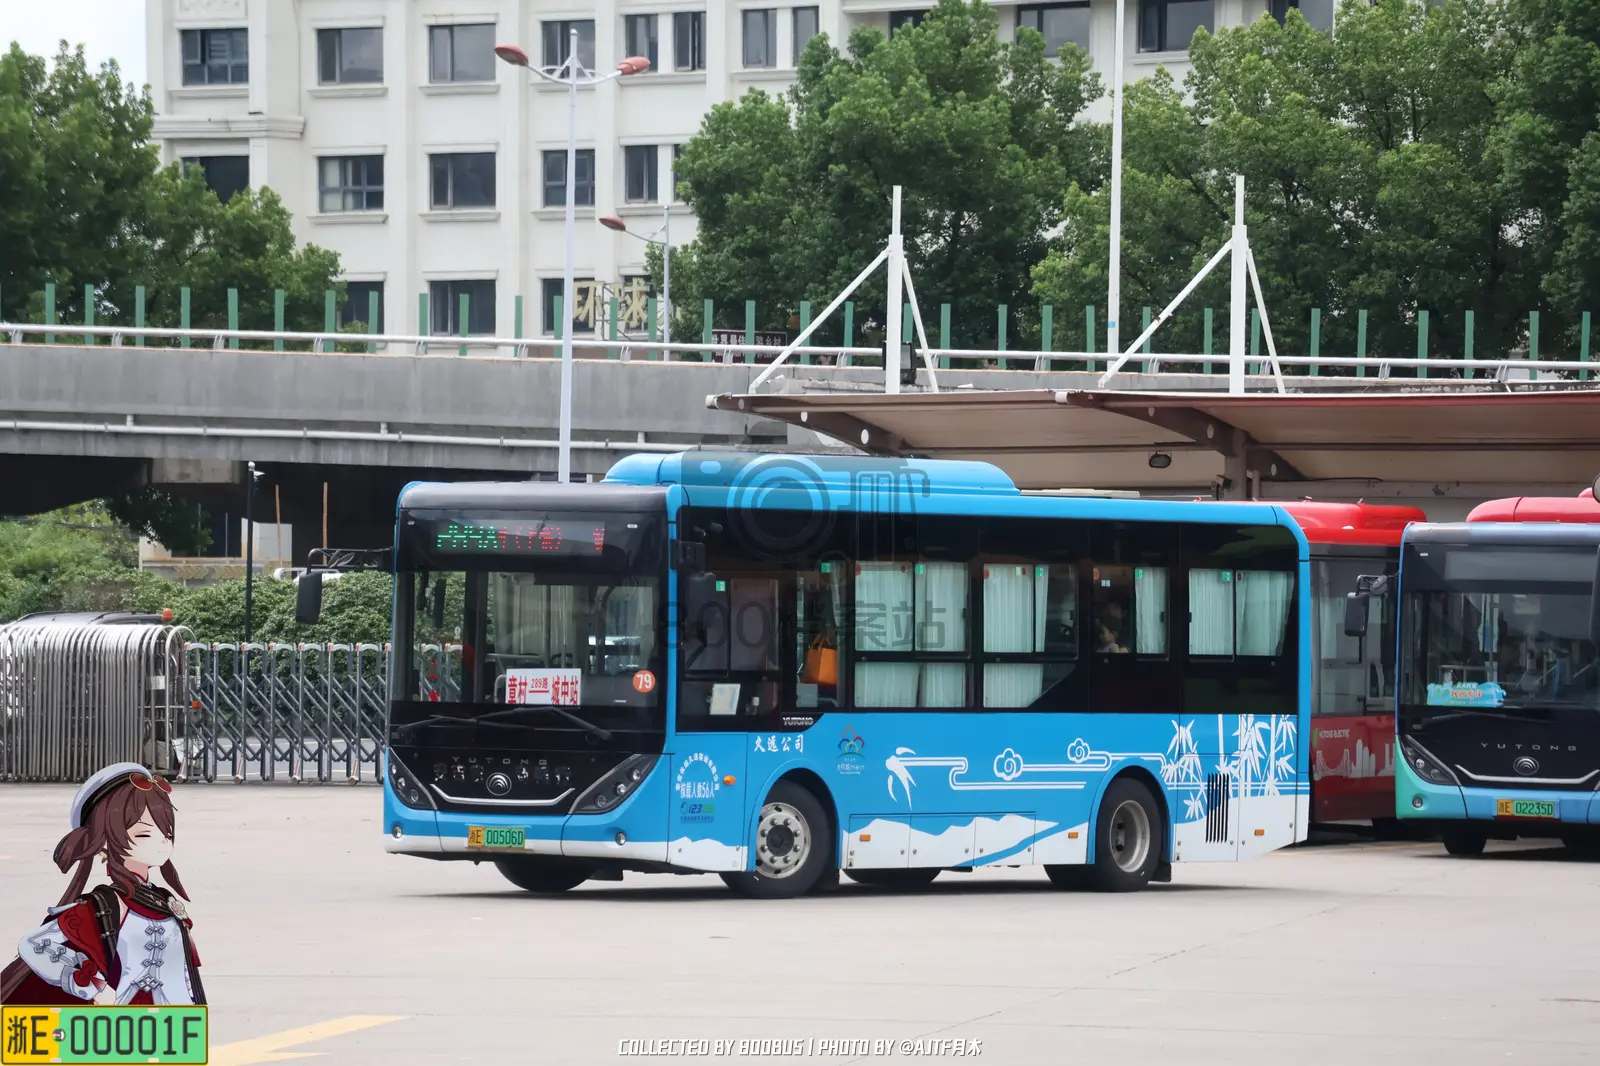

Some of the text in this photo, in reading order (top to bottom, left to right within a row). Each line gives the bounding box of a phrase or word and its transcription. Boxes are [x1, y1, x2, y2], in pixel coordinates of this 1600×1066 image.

[573, 277, 682, 330] 环球
[531, 678, 549, 689] 289路
[637, 674, 652, 689] 79
[1481, 742, 1577, 751] YUTONG
[452, 756, 548, 766] YUTONG
